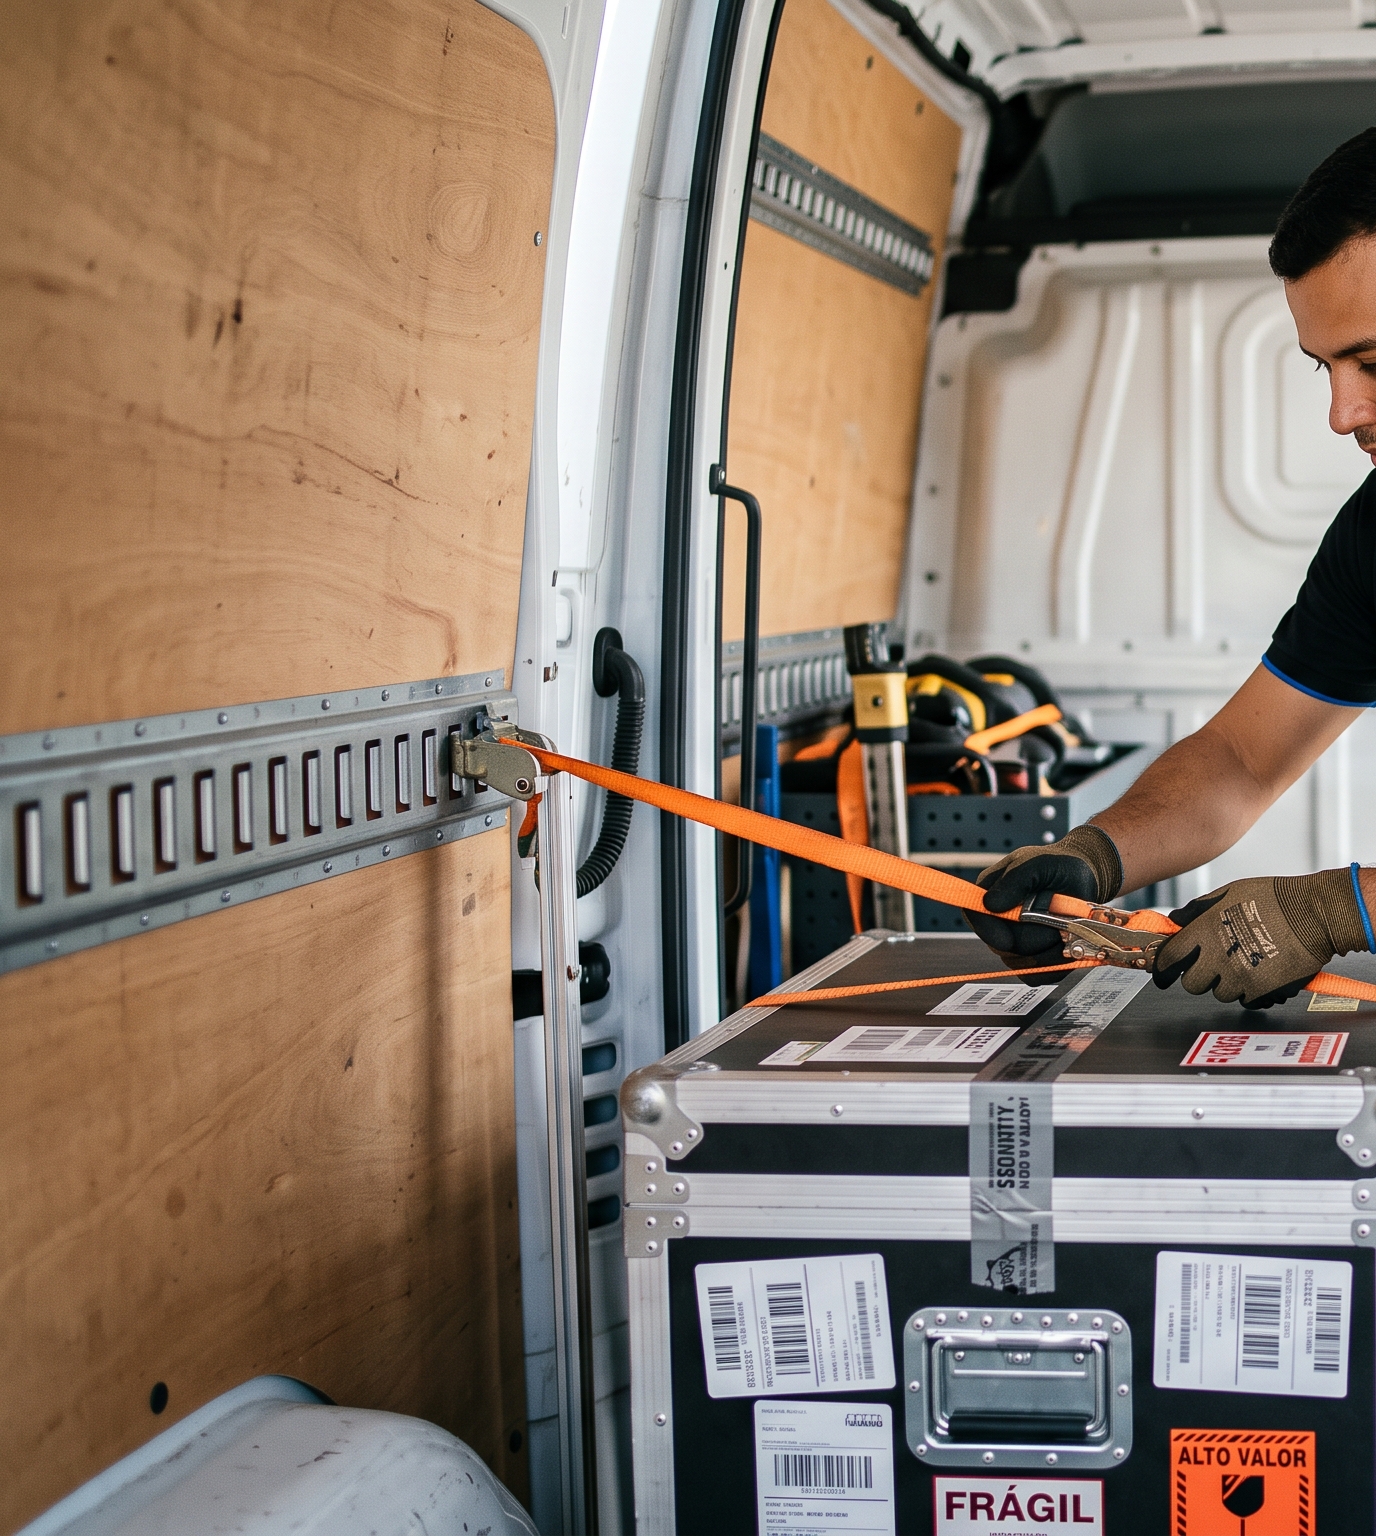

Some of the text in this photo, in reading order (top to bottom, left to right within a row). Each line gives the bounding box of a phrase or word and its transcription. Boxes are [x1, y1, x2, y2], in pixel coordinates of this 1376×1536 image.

[1178, 1446, 1307, 1468] ALTO VALOR
[945, 1484, 1095, 1523] FRÁGIL
